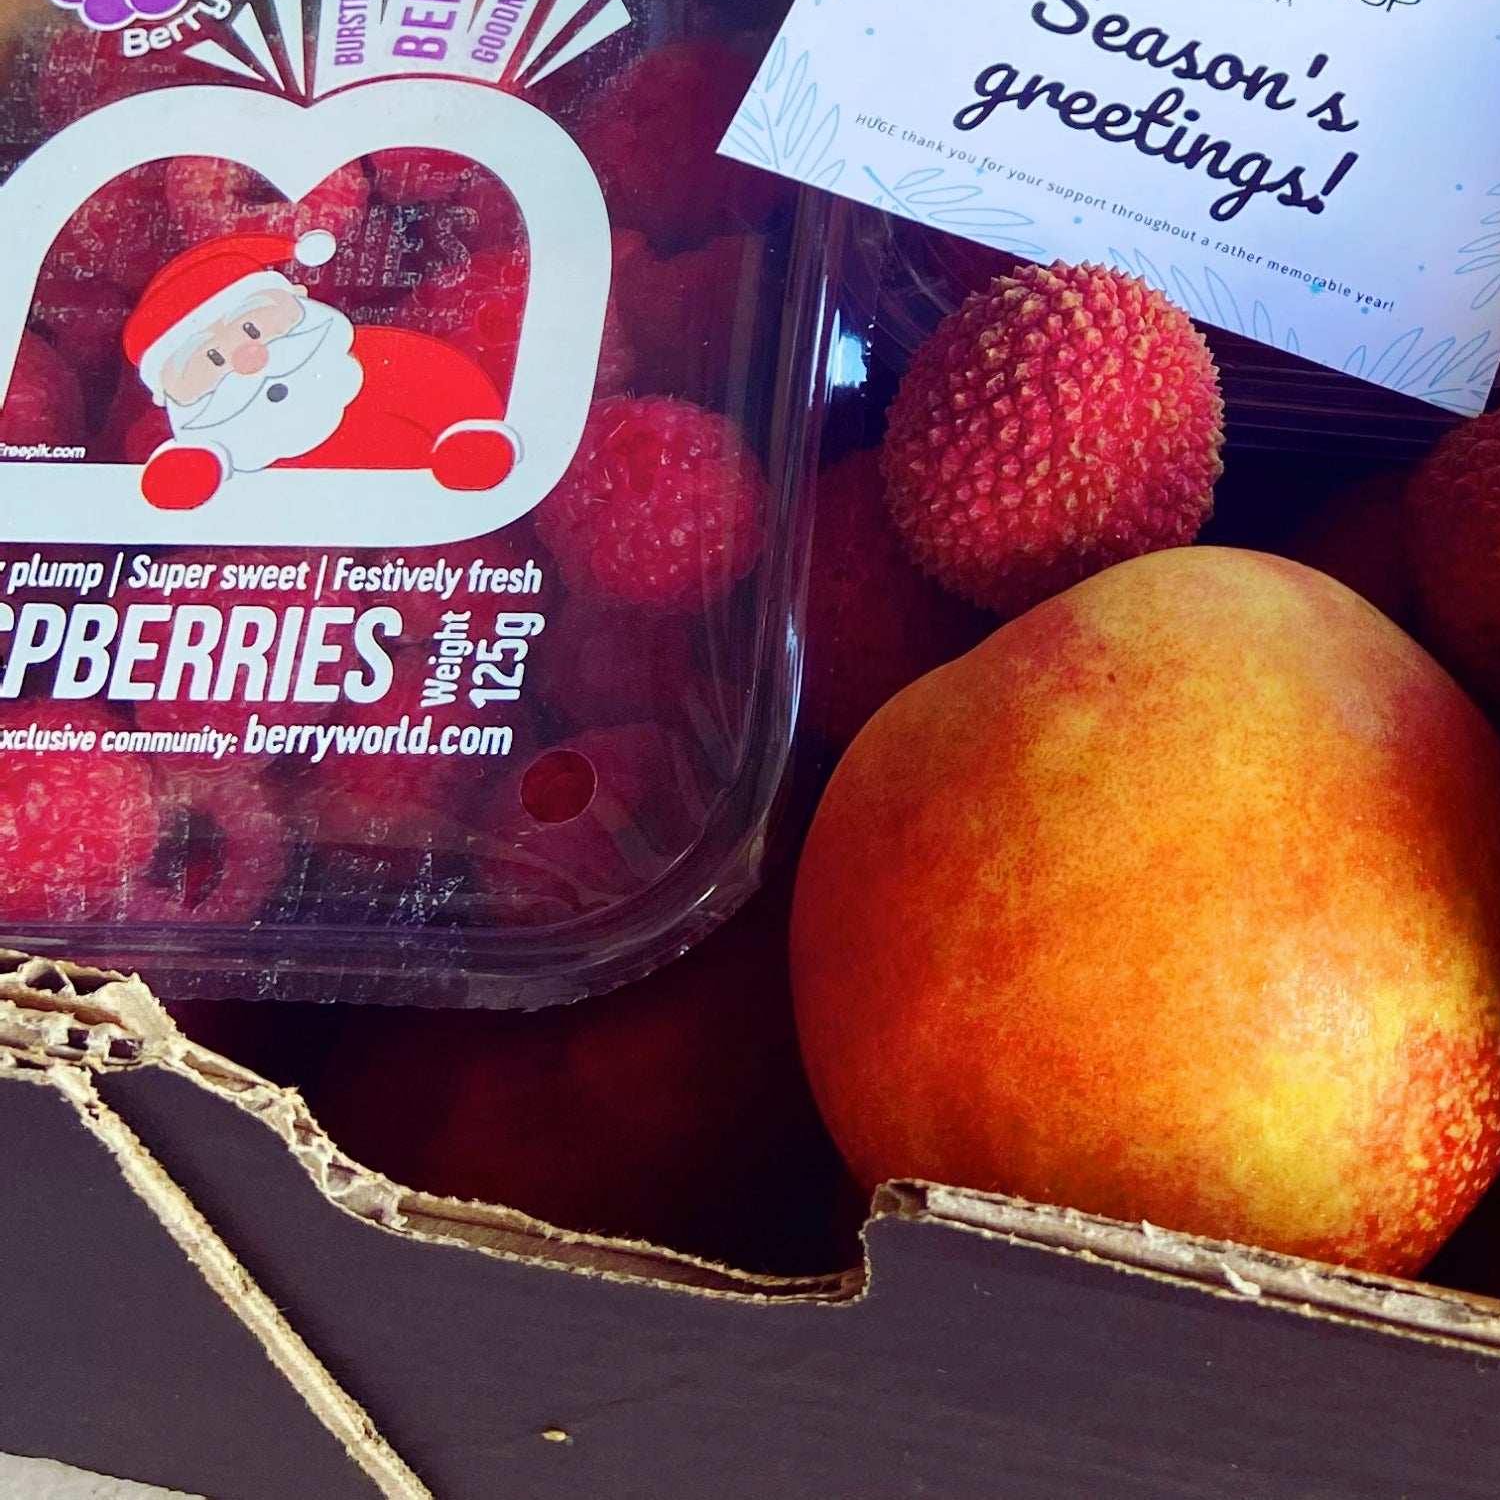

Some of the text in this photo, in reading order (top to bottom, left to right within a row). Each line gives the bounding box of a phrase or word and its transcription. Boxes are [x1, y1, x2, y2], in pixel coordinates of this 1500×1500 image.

[952, 62, 1360, 222] greetings!
[855, 113, 1396, 313] HUGE thank you for your support throughout a rather memorable year!
[7, 553, 543, 599] plump Super sweet Festively fresh
[420, 610, 473, 708] Weight
[469, 611, 546, 710] 125g
[0, 714, 514, 764] xclusive community: berryworld.com
